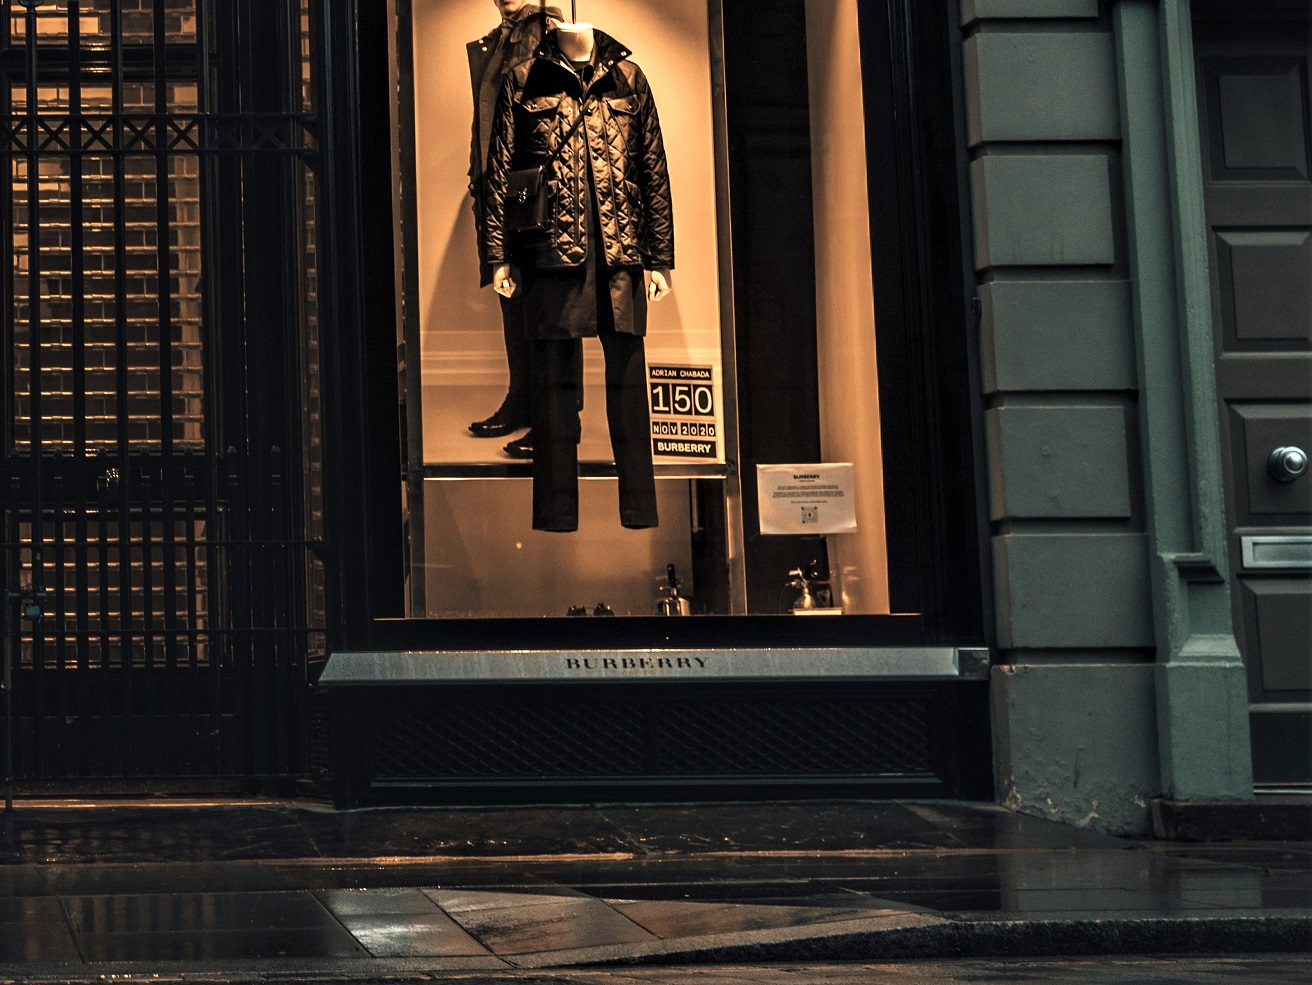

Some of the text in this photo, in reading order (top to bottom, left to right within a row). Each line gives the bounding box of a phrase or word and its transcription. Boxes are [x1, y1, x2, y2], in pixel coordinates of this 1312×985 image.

[651, 369, 710, 378] ADRIAN CHABADA
[652, 385, 712, 414] 150
[653, 424, 715, 436] NOV 2020
[657, 441, 711, 454] BURBERRY
[565, 657, 708, 670] BURBERRY
